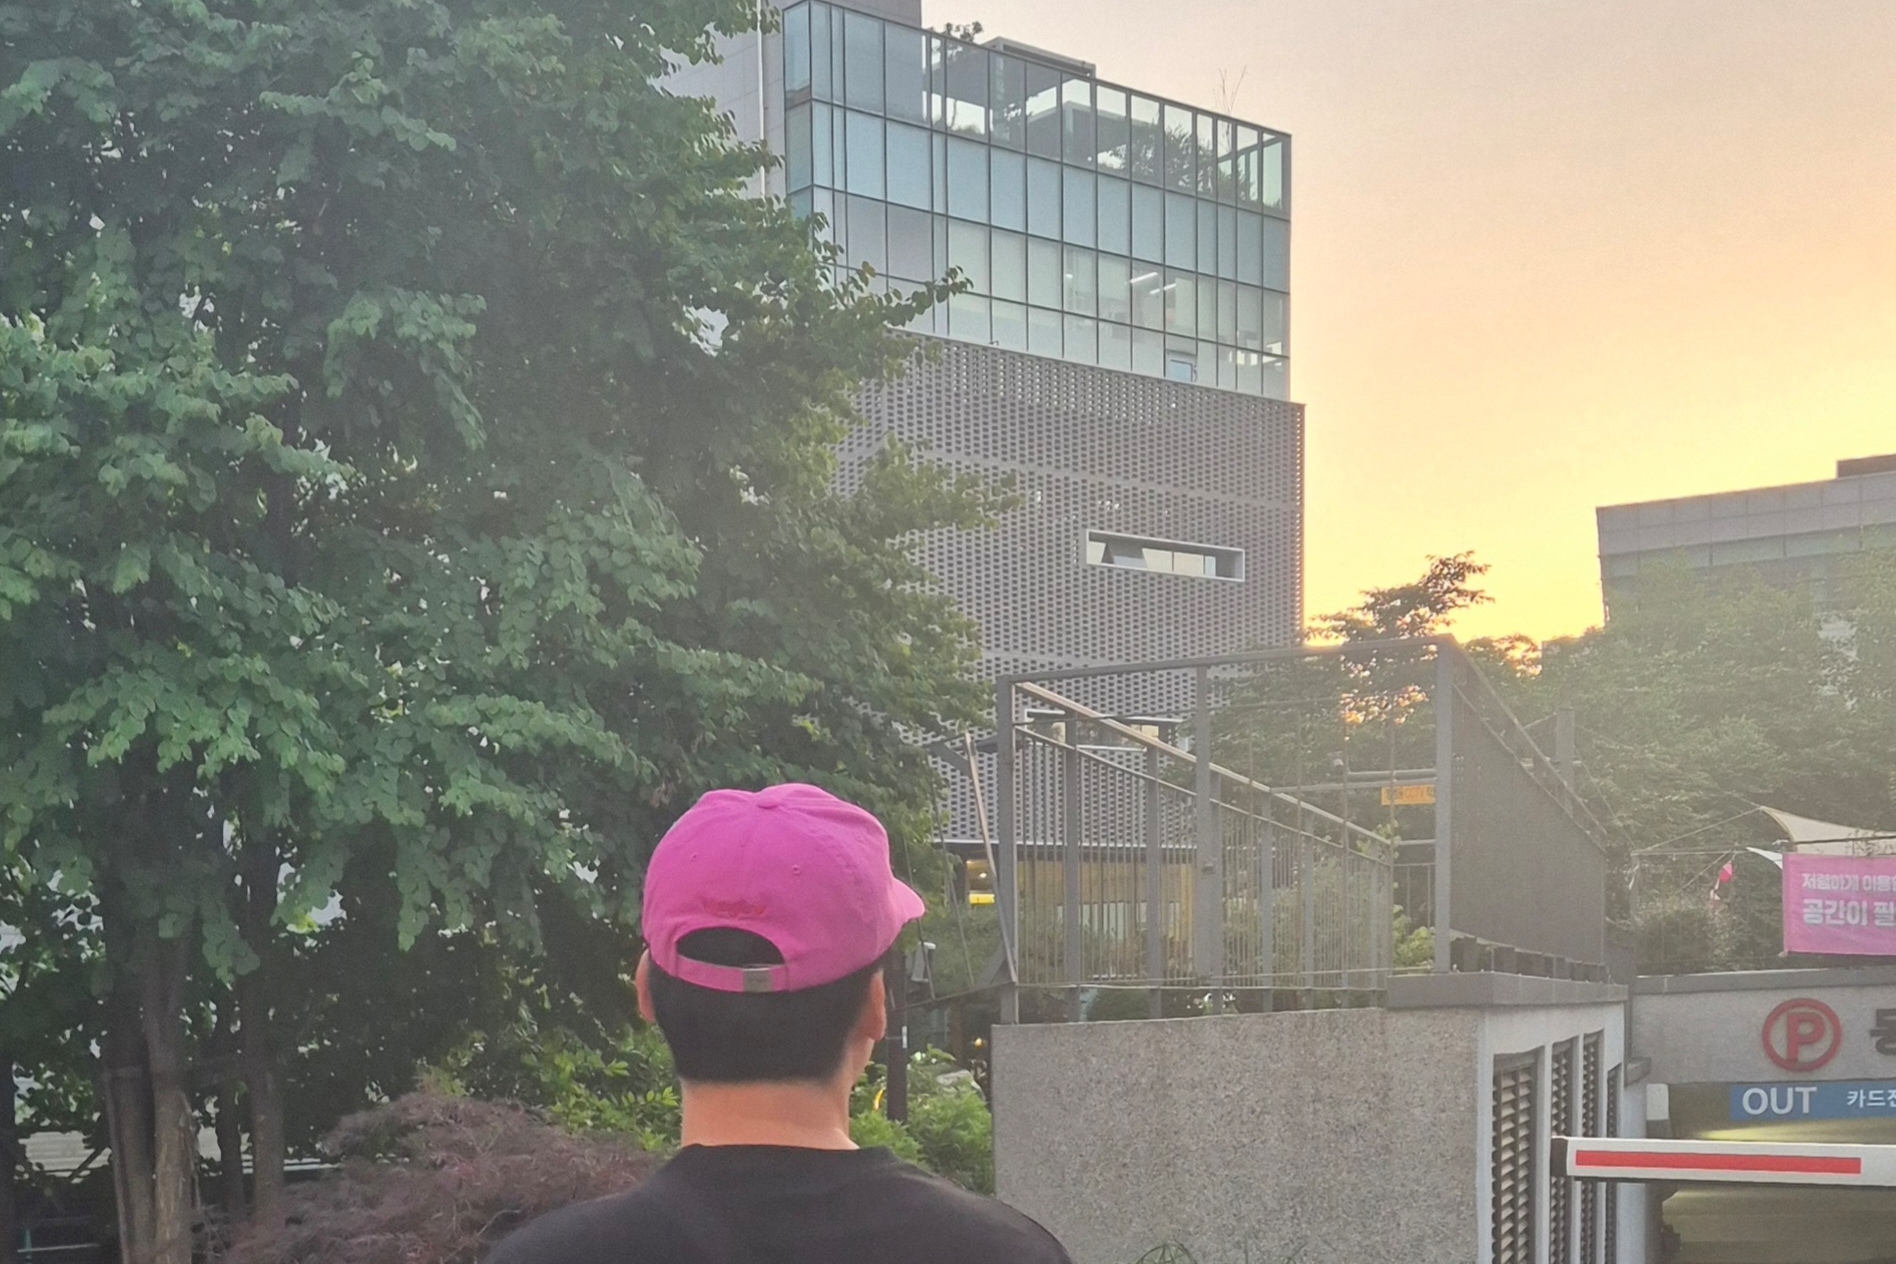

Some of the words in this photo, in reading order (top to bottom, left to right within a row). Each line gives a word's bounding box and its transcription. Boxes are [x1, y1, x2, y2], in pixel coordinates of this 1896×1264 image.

[1862, 874, 1896, 892] 이용
[1803, 898, 1868, 926] 공간이
[1742, 1086, 1817, 1115] OUT
